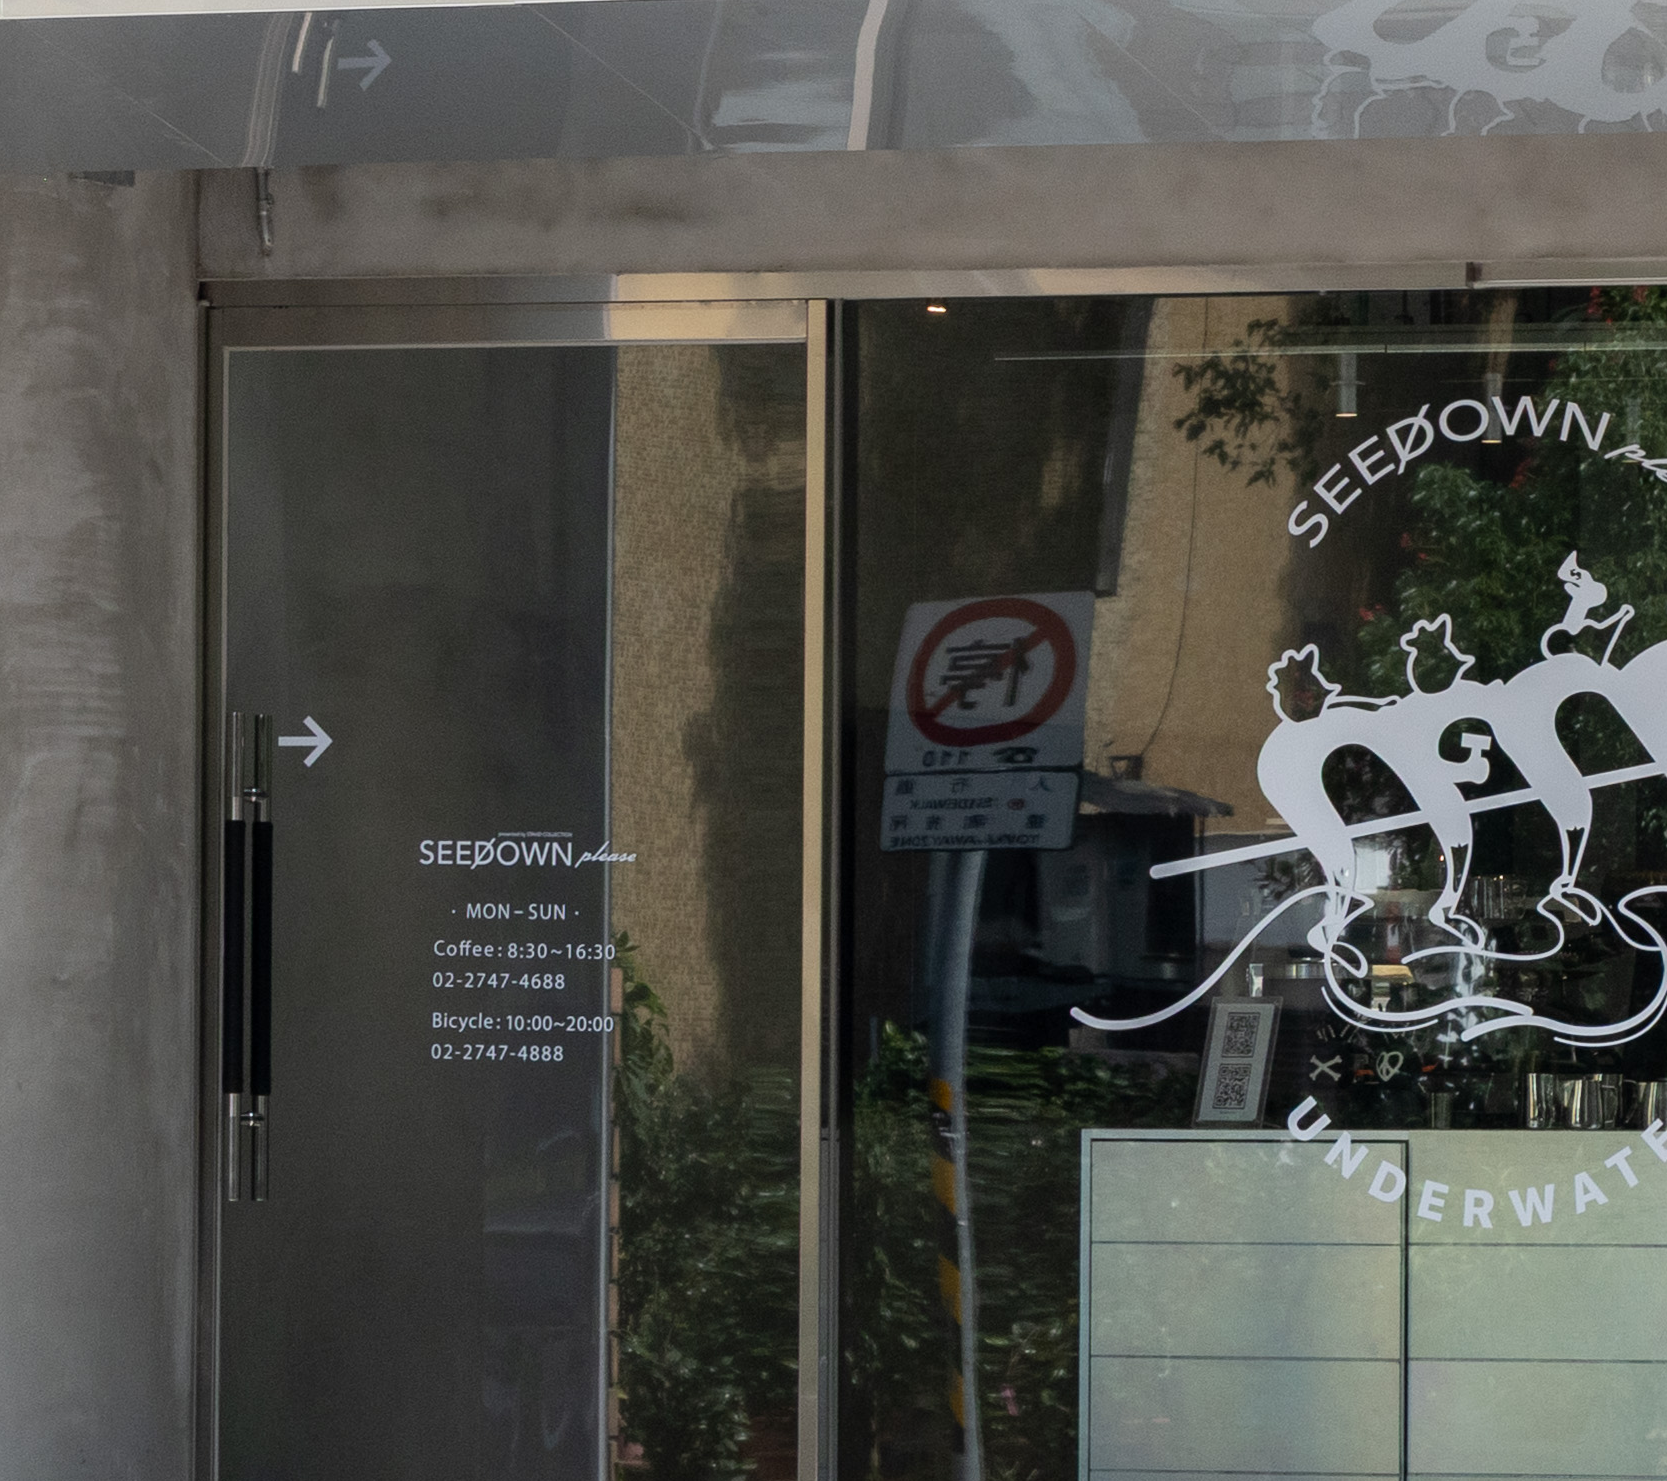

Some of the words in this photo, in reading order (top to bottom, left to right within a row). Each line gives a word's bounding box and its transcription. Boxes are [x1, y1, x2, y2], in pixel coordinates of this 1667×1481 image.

[1286, 394, 1611, 548] SEEDOWN
[418, 837, 574, 870] SEEDOWN
[574, 840, 637, 869] please
[432, 971, 566, 990] 02-2747-4688
[430, 1043, 565, 1062] 02-2747-4888
